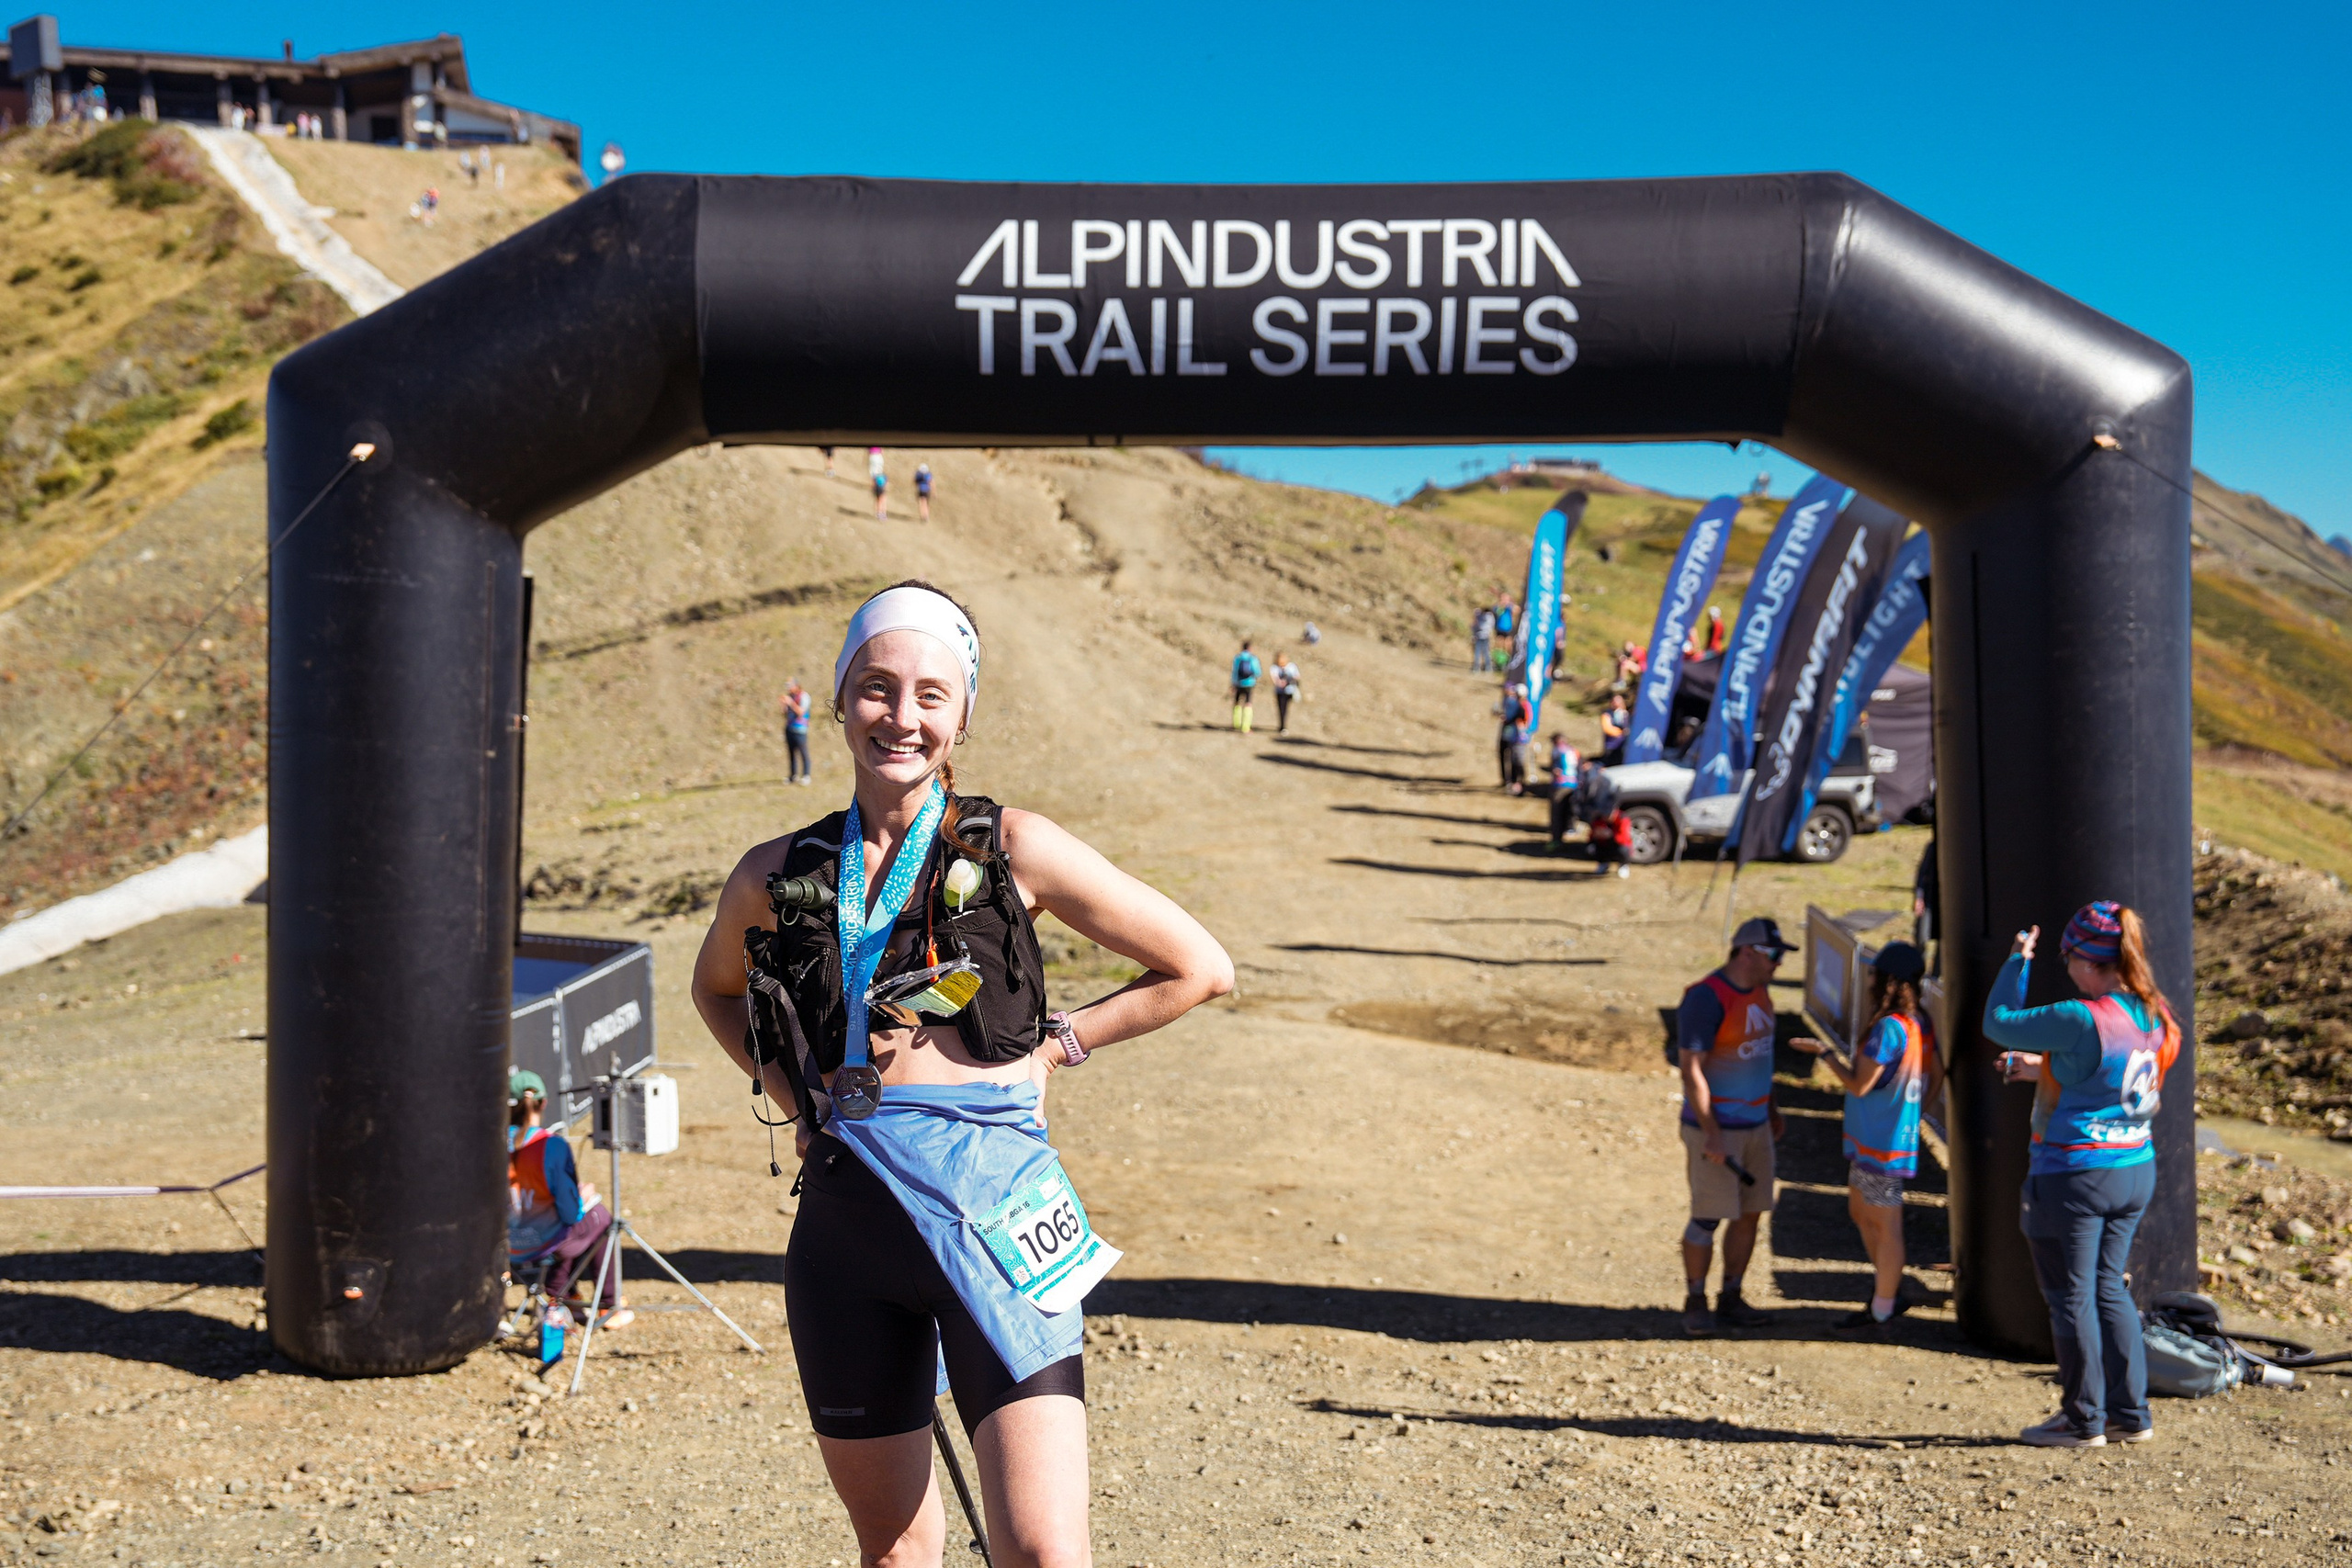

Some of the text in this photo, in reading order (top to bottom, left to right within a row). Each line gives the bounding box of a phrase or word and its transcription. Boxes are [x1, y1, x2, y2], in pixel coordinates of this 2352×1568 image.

[956, 219, 1582, 289] ALPINDUSTRIA
[955, 294, 1580, 377] TRAIL SERIES
[1645, 516, 1724, 716] ALPINDUSTRIA
[1721, 498, 1830, 724] ALPINDUSTRIA
[856, 940, 874, 980] SOUTH
[982, 1217, 1005, 1235] SOUTH
[1023, 1201, 1031, 1209] 16
[1017, 1200, 1080, 1265] 1065
